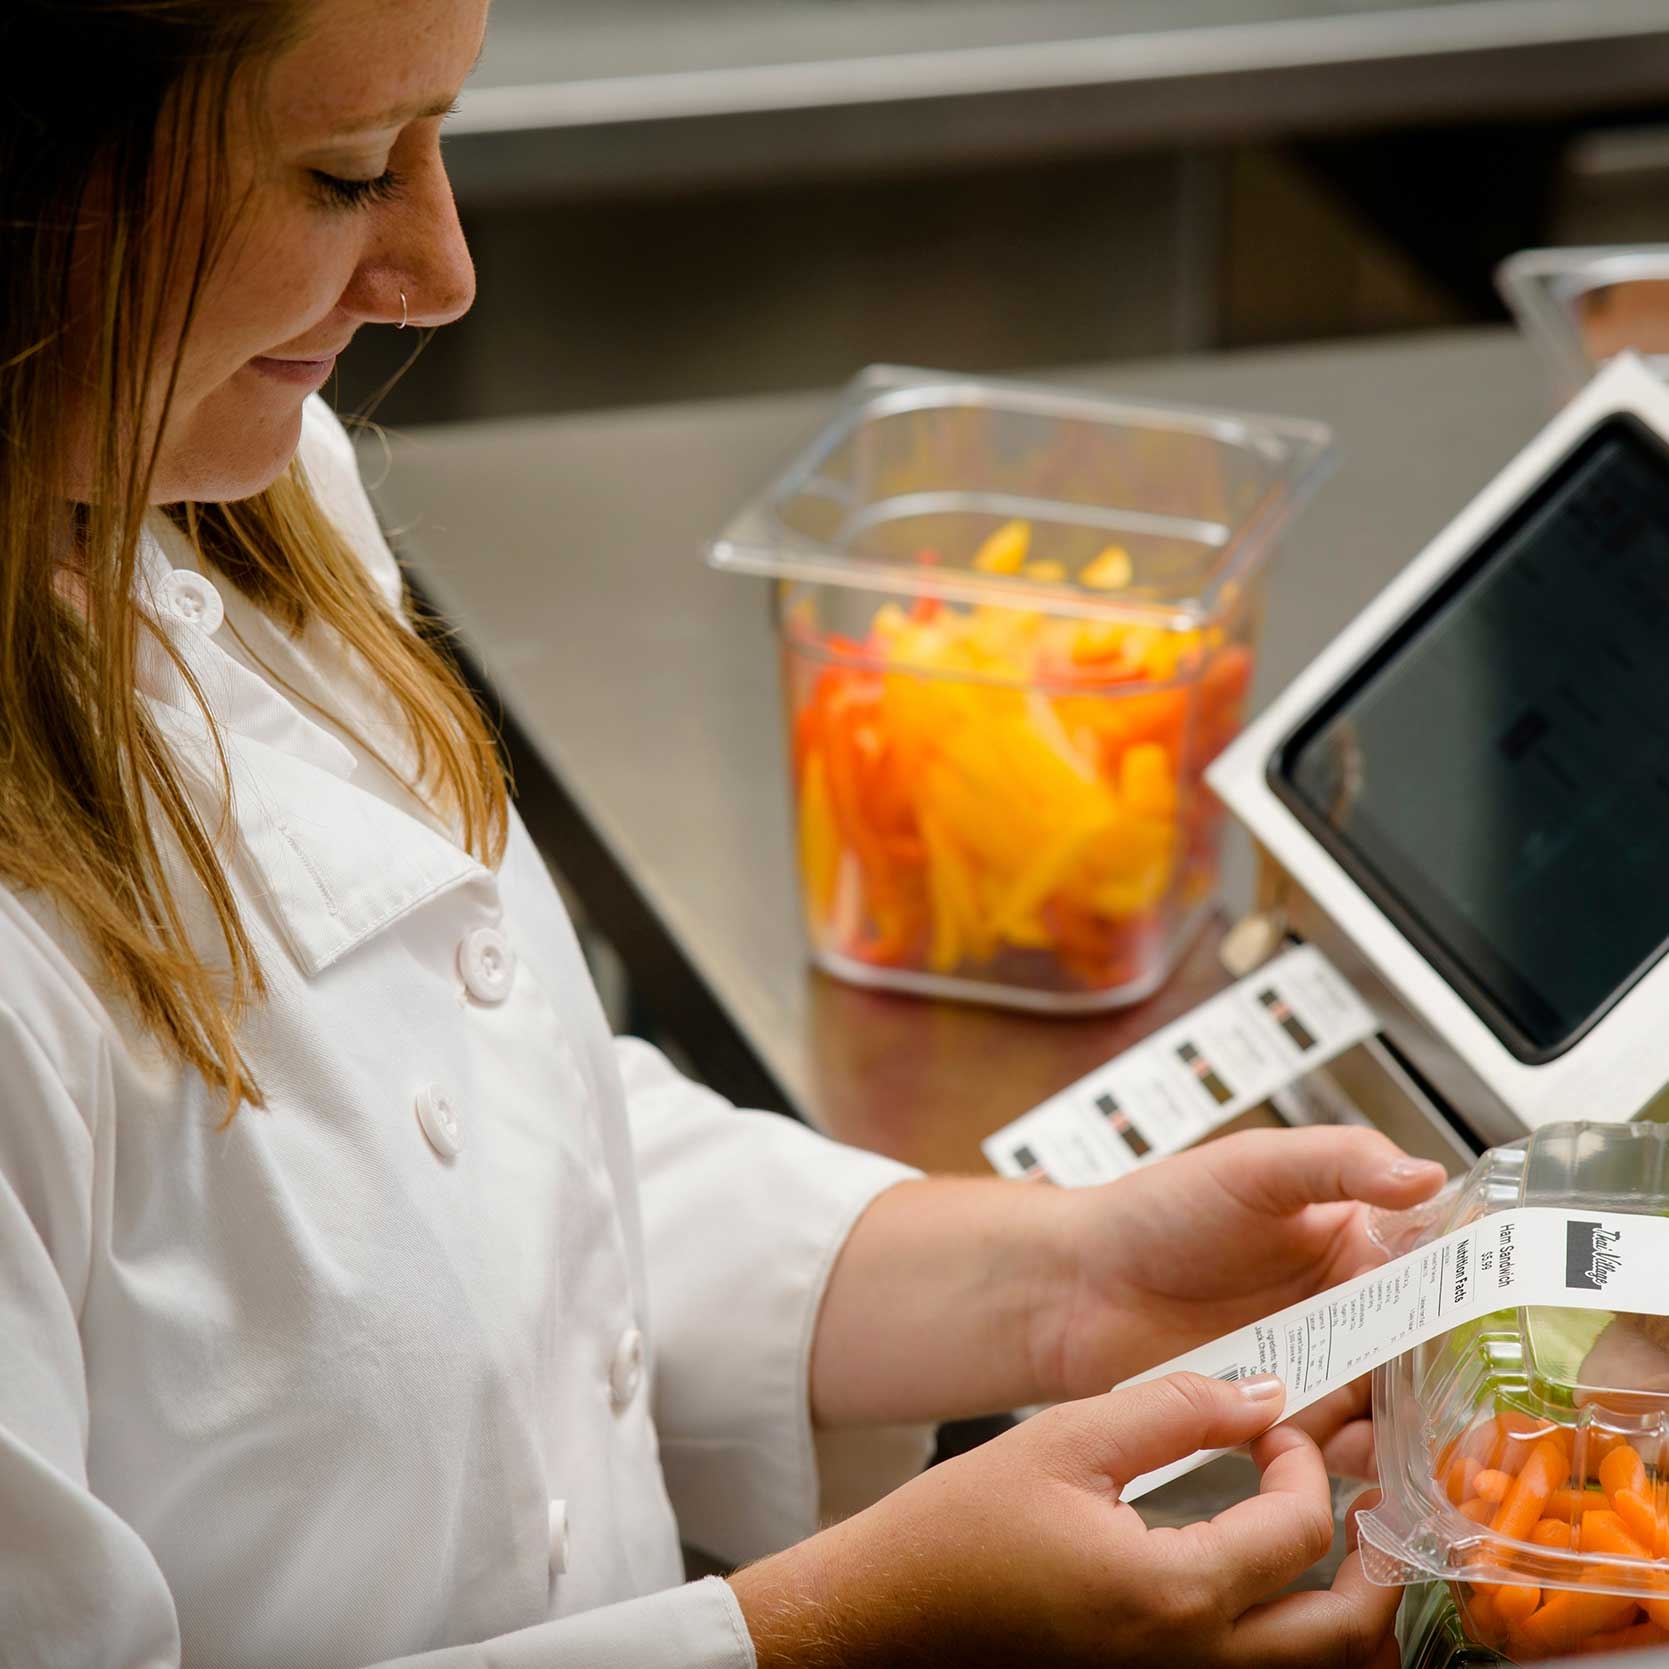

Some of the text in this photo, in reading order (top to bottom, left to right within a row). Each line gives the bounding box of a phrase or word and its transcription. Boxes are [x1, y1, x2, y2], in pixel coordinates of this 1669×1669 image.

[1454, 1239, 1470, 1303] Nutrition Facts
[1481, 1251, 1493, 1271] $5.99
[1498, 1223, 1515, 1288] Ham Sandwich
[1585, 1228, 1622, 1285] Thai Village
